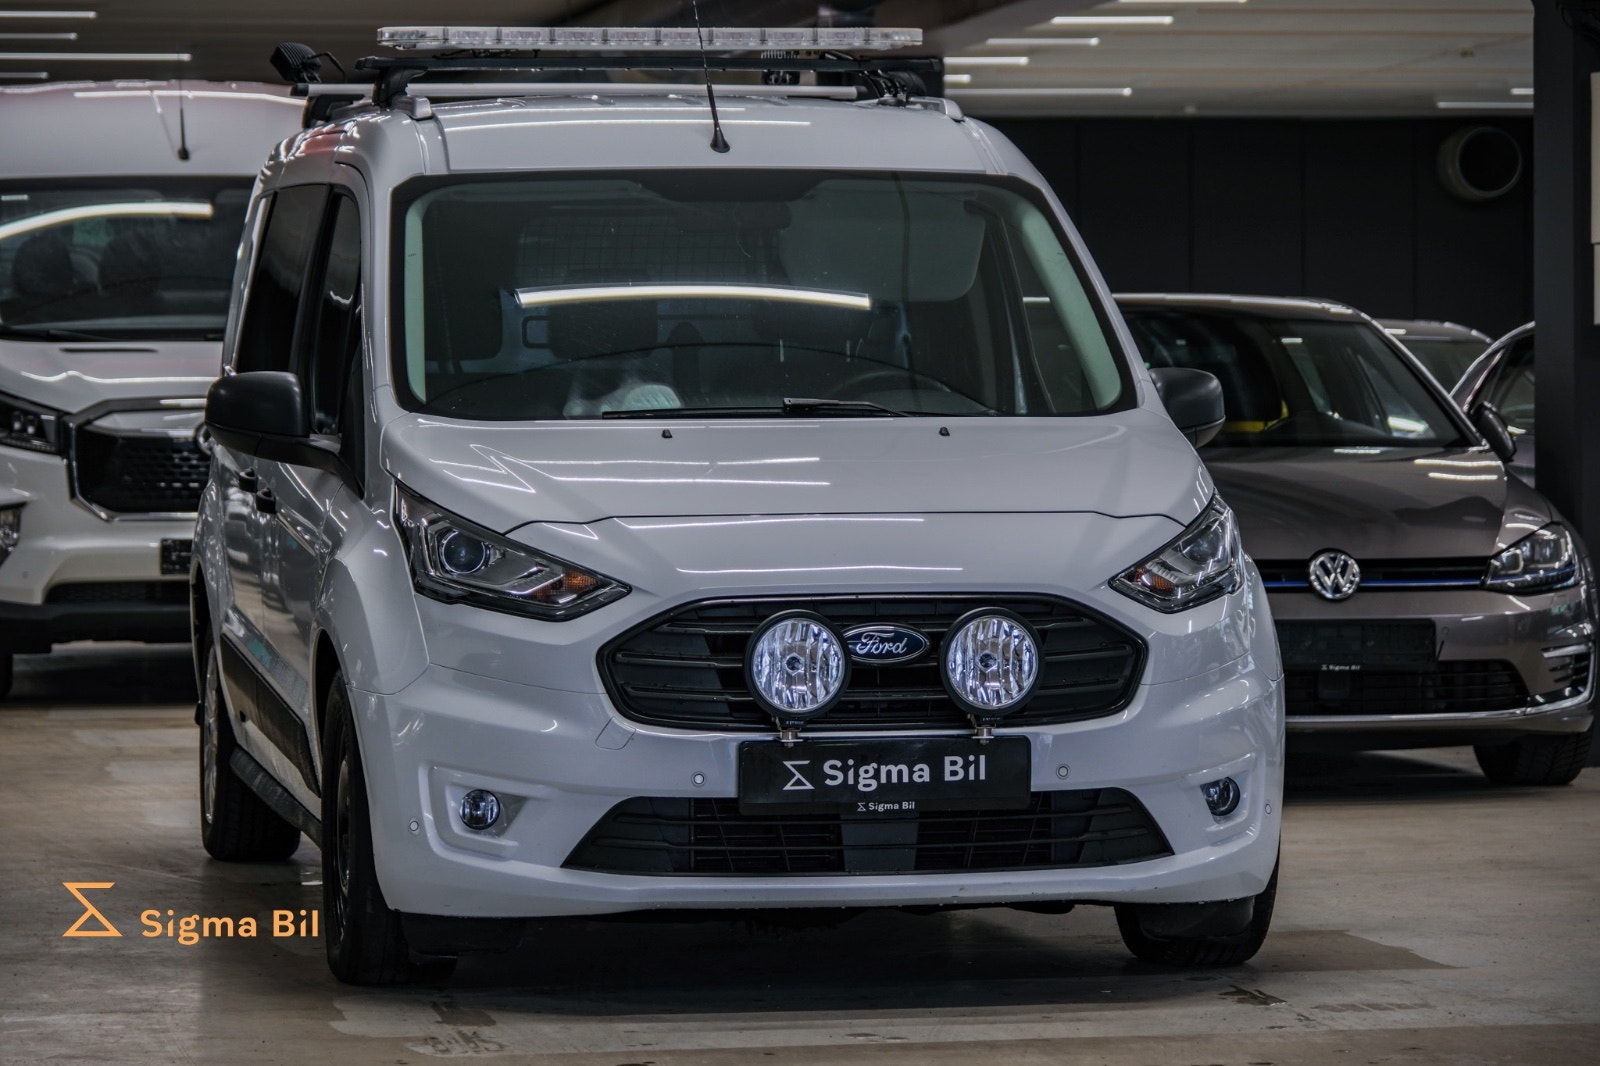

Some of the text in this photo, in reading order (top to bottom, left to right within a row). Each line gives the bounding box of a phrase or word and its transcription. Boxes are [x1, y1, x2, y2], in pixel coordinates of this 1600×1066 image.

[856, 632, 908, 654] Ford
[823, 754, 986, 792] Sigma Bil
[868, 801, 915, 813] Sigma Bil
